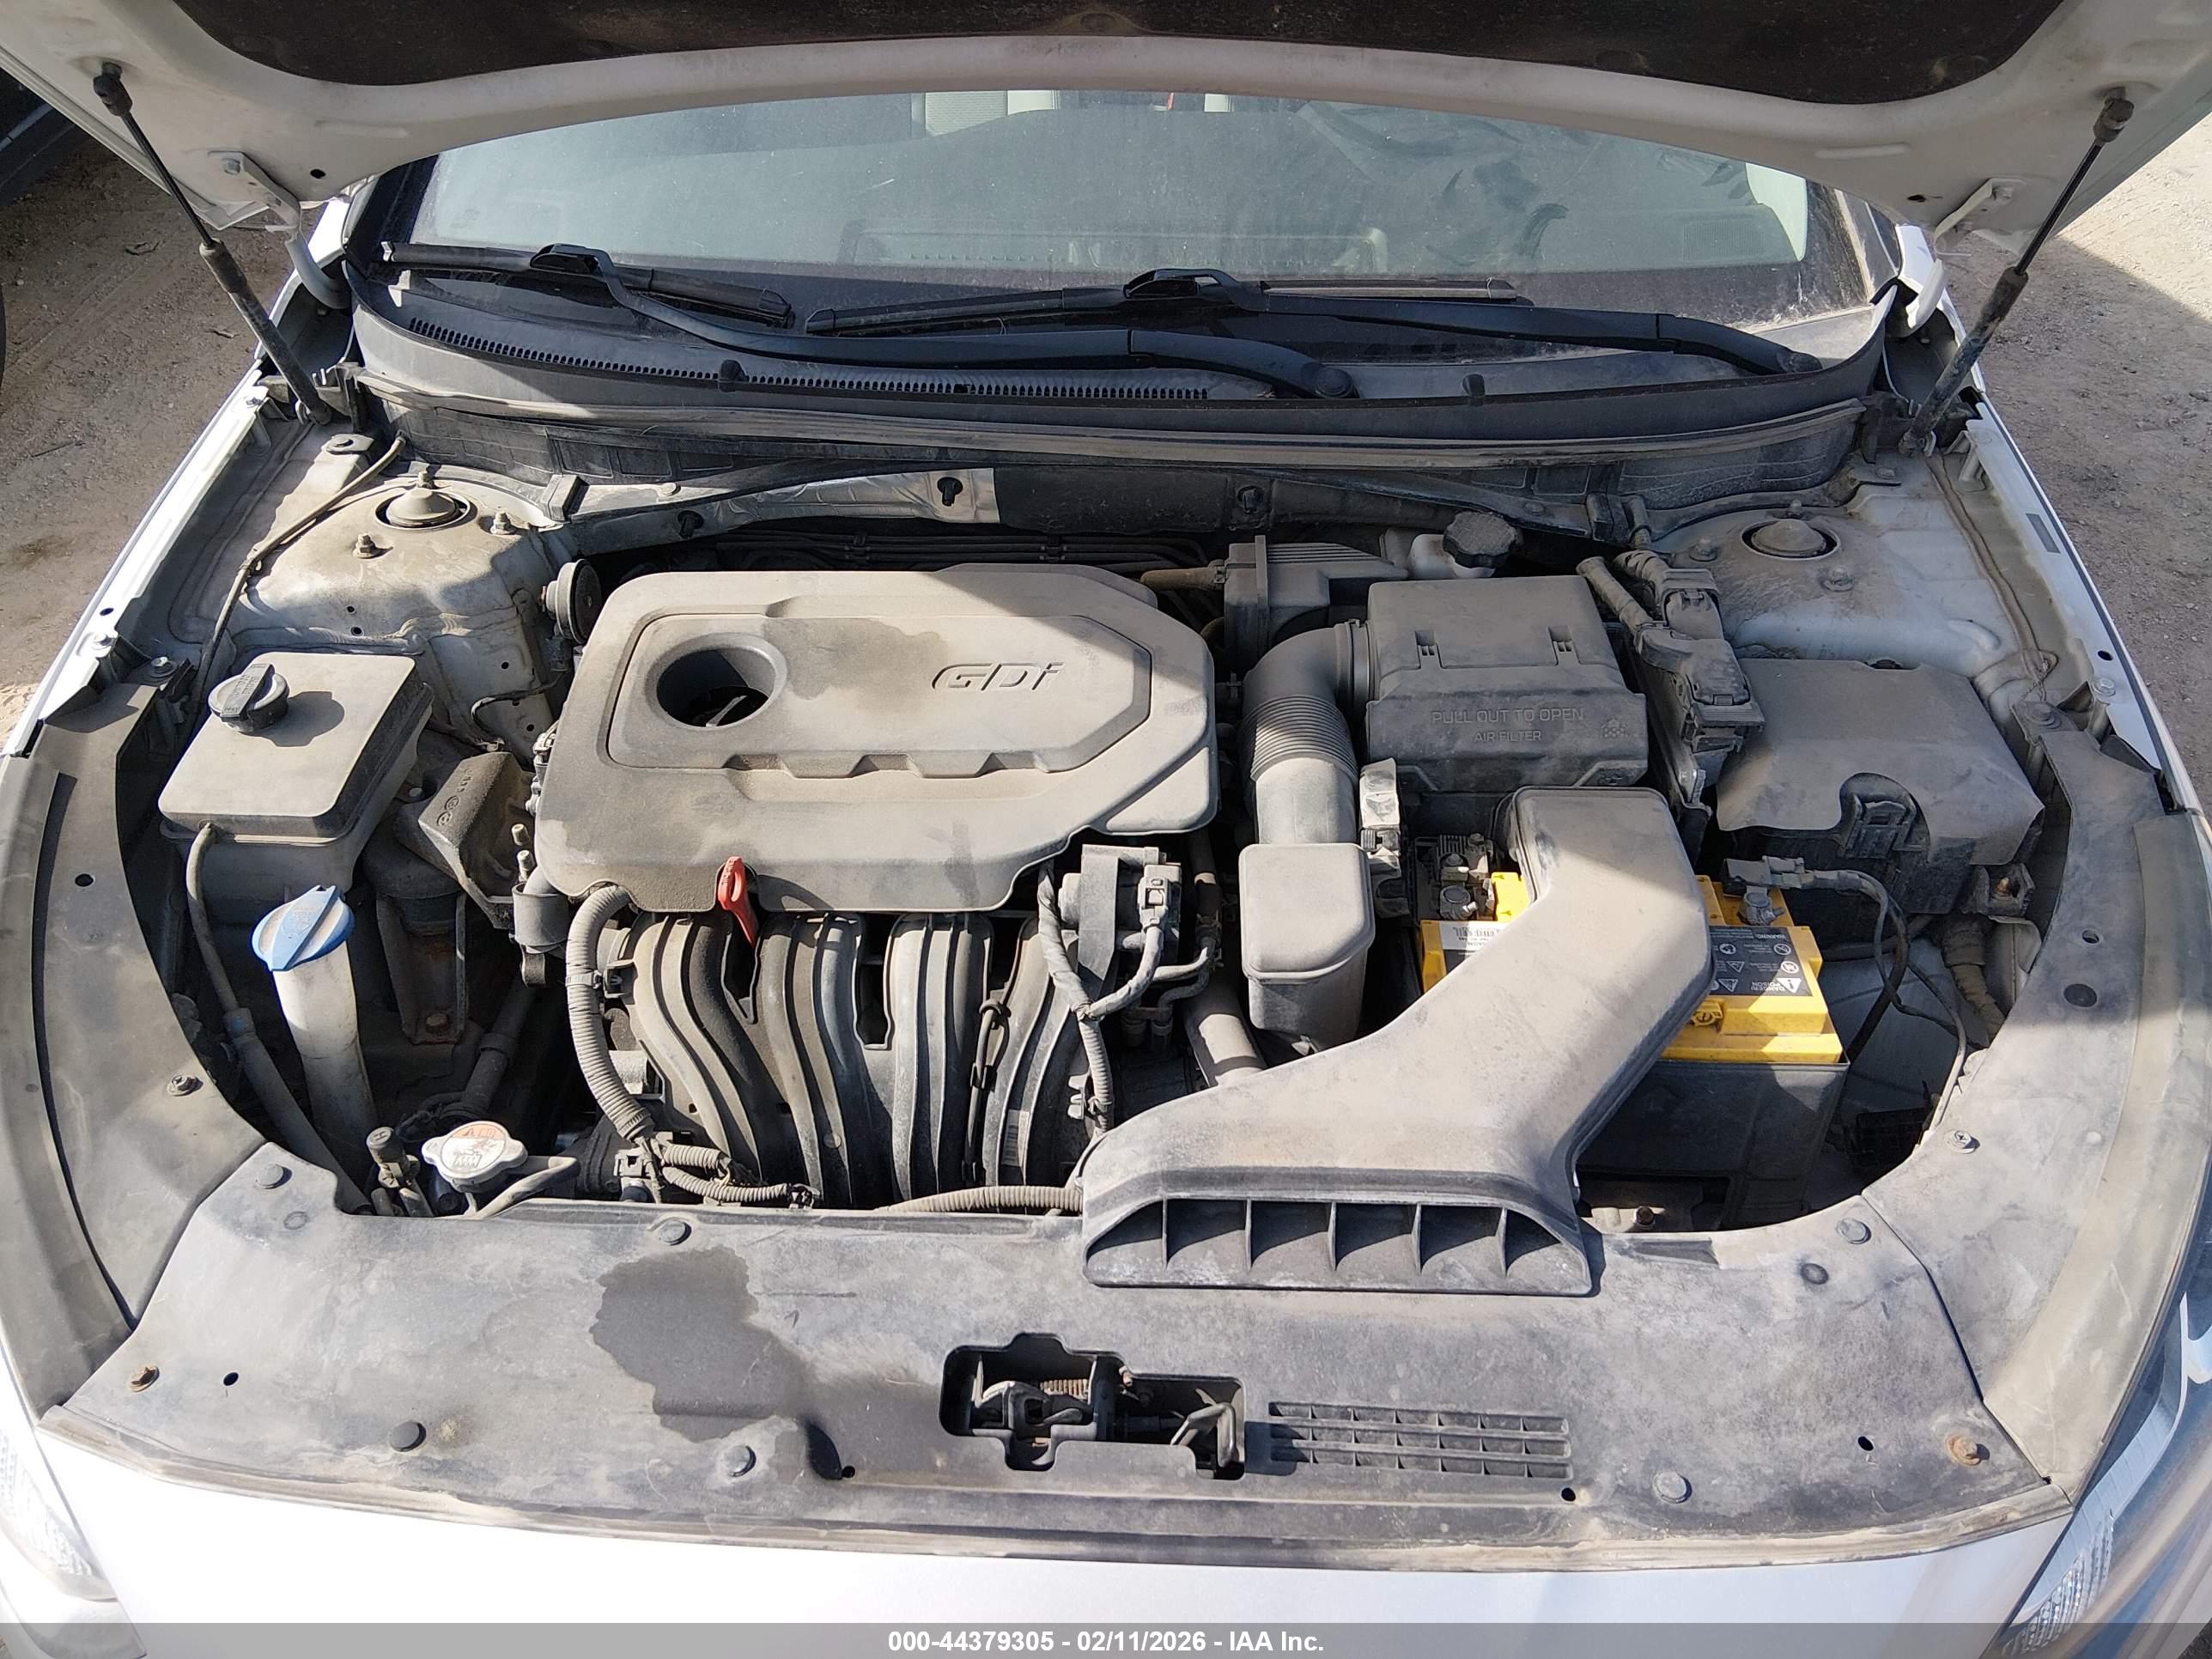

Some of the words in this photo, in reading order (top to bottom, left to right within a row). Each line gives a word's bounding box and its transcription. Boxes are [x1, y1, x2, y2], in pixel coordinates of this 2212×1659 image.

[932, 662, 1065, 691] GDi
[1432, 711, 1473, 724] PULL
[1476, 709, 1510, 723] OUT
[1514, 708, 1534, 722] TO
[1539, 708, 1584, 722] OPEN
[1474, 732, 1496, 743] AIR
[1499, 731, 1542, 742] FILTER
